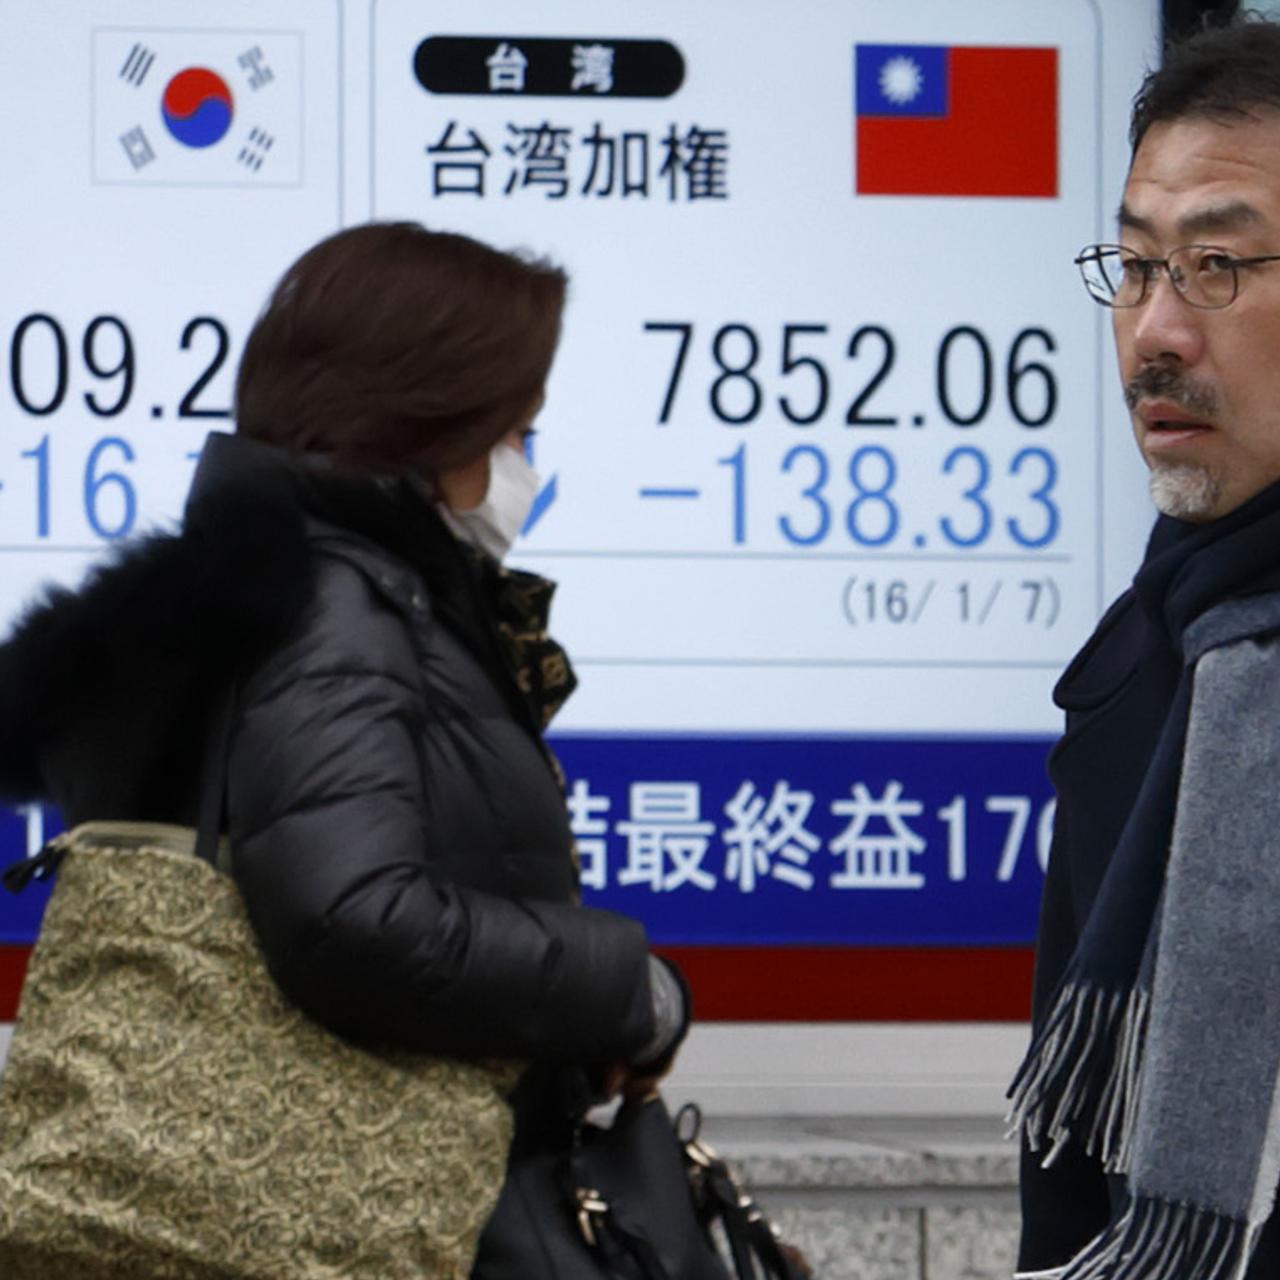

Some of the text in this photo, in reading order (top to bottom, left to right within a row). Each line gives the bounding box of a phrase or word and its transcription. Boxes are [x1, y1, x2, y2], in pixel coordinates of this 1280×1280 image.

[486, 42, 615, 93] 台湾
[425, 120, 729, 202] 台湾加権
[643, 321, 1060, 430] 7852.06
[638, 442, 1061, 551] -138.33
